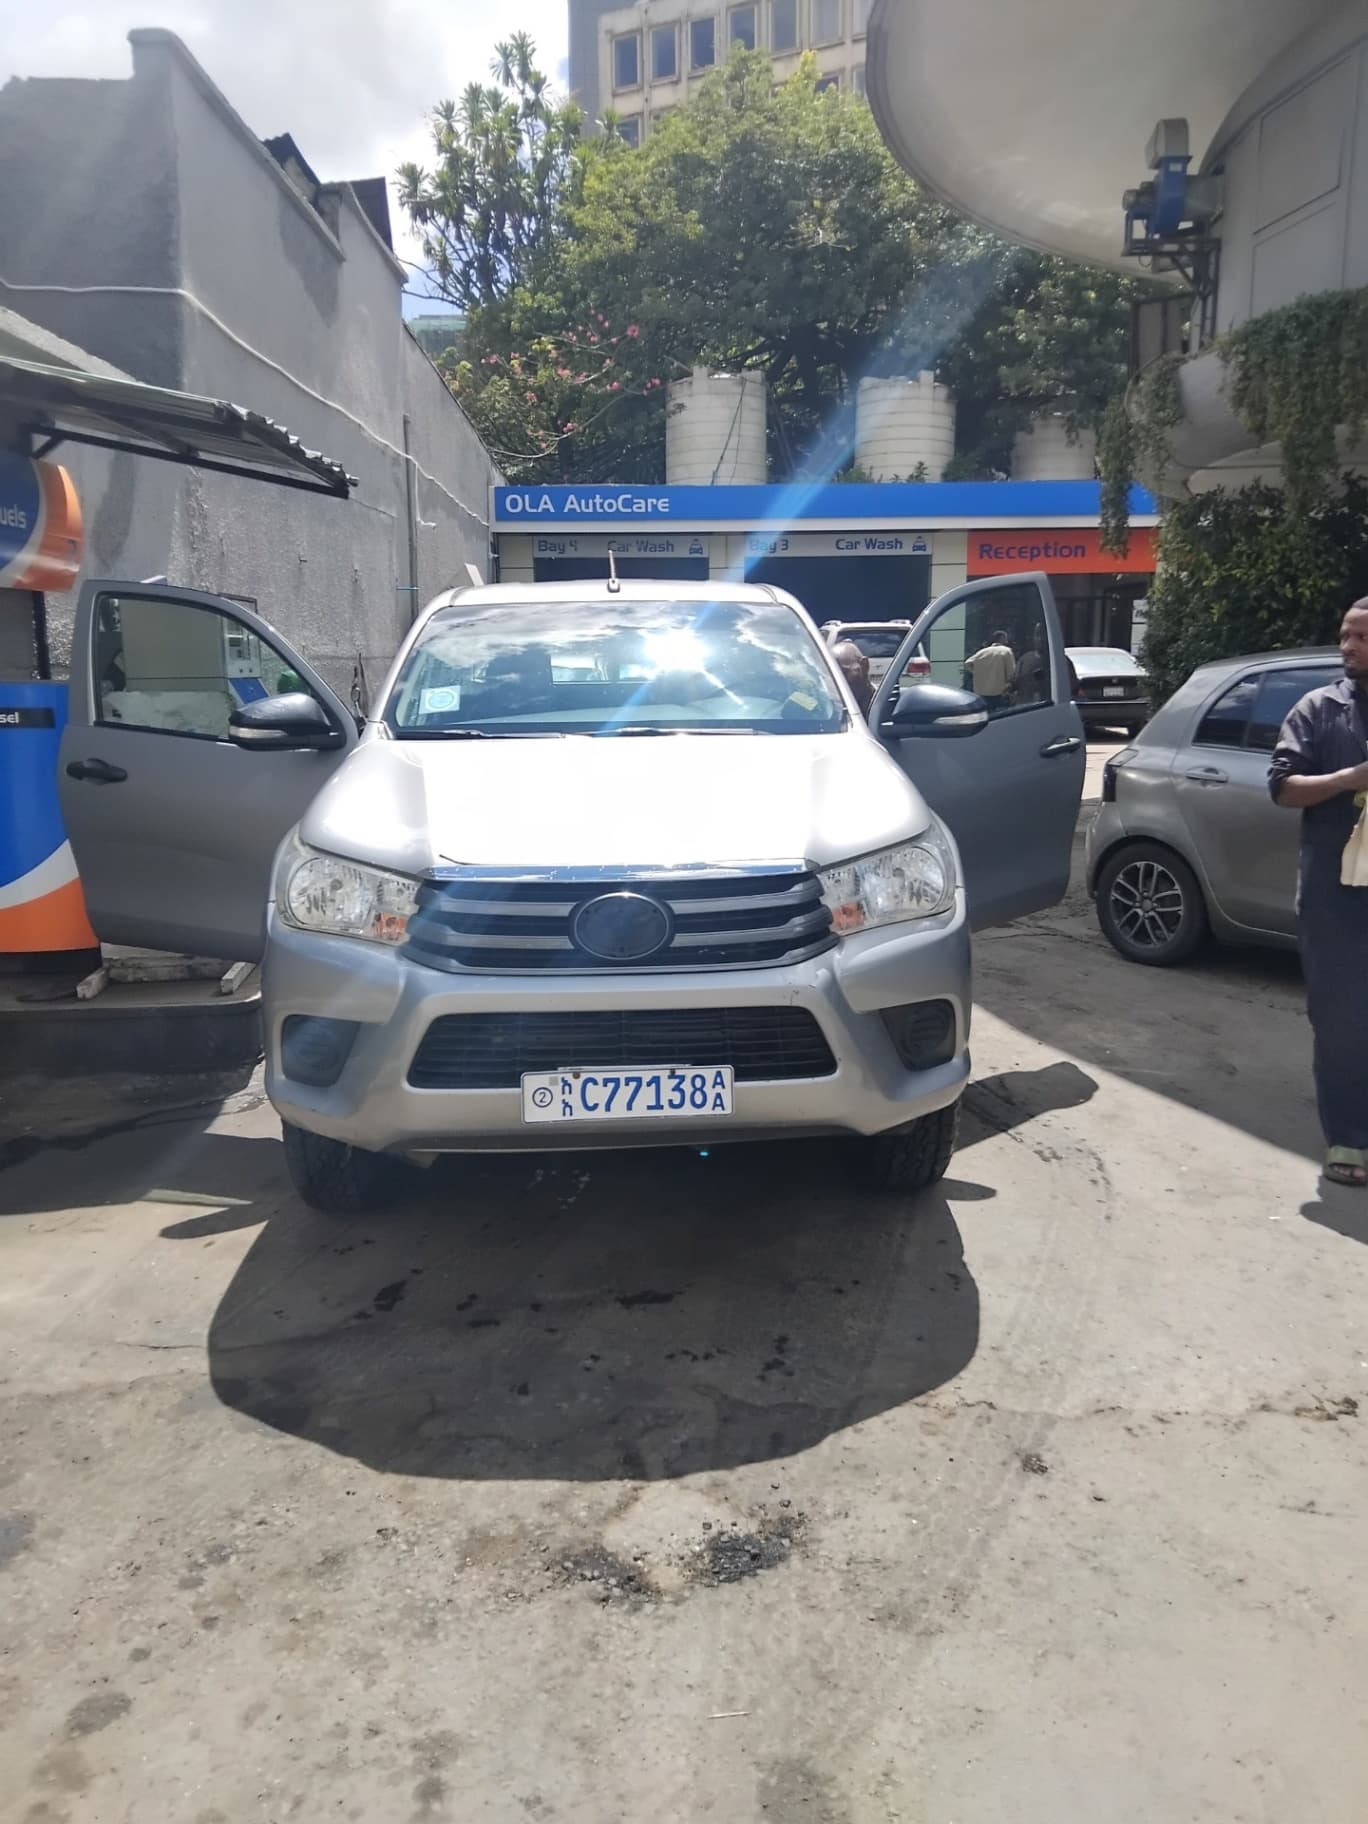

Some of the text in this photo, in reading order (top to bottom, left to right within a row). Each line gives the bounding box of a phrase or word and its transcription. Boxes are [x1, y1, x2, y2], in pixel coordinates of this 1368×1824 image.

[504, 493, 670, 513] OLA AutoCare
[538, 539, 566, 555] Bay
[607, 538, 675, 553] Car Wash
[748, 538, 790, 555] Bay 3
[835, 536, 904, 552] Car Wash
[978, 540, 1087, 562] Reception
[580, 1073, 708, 1113] C77138
